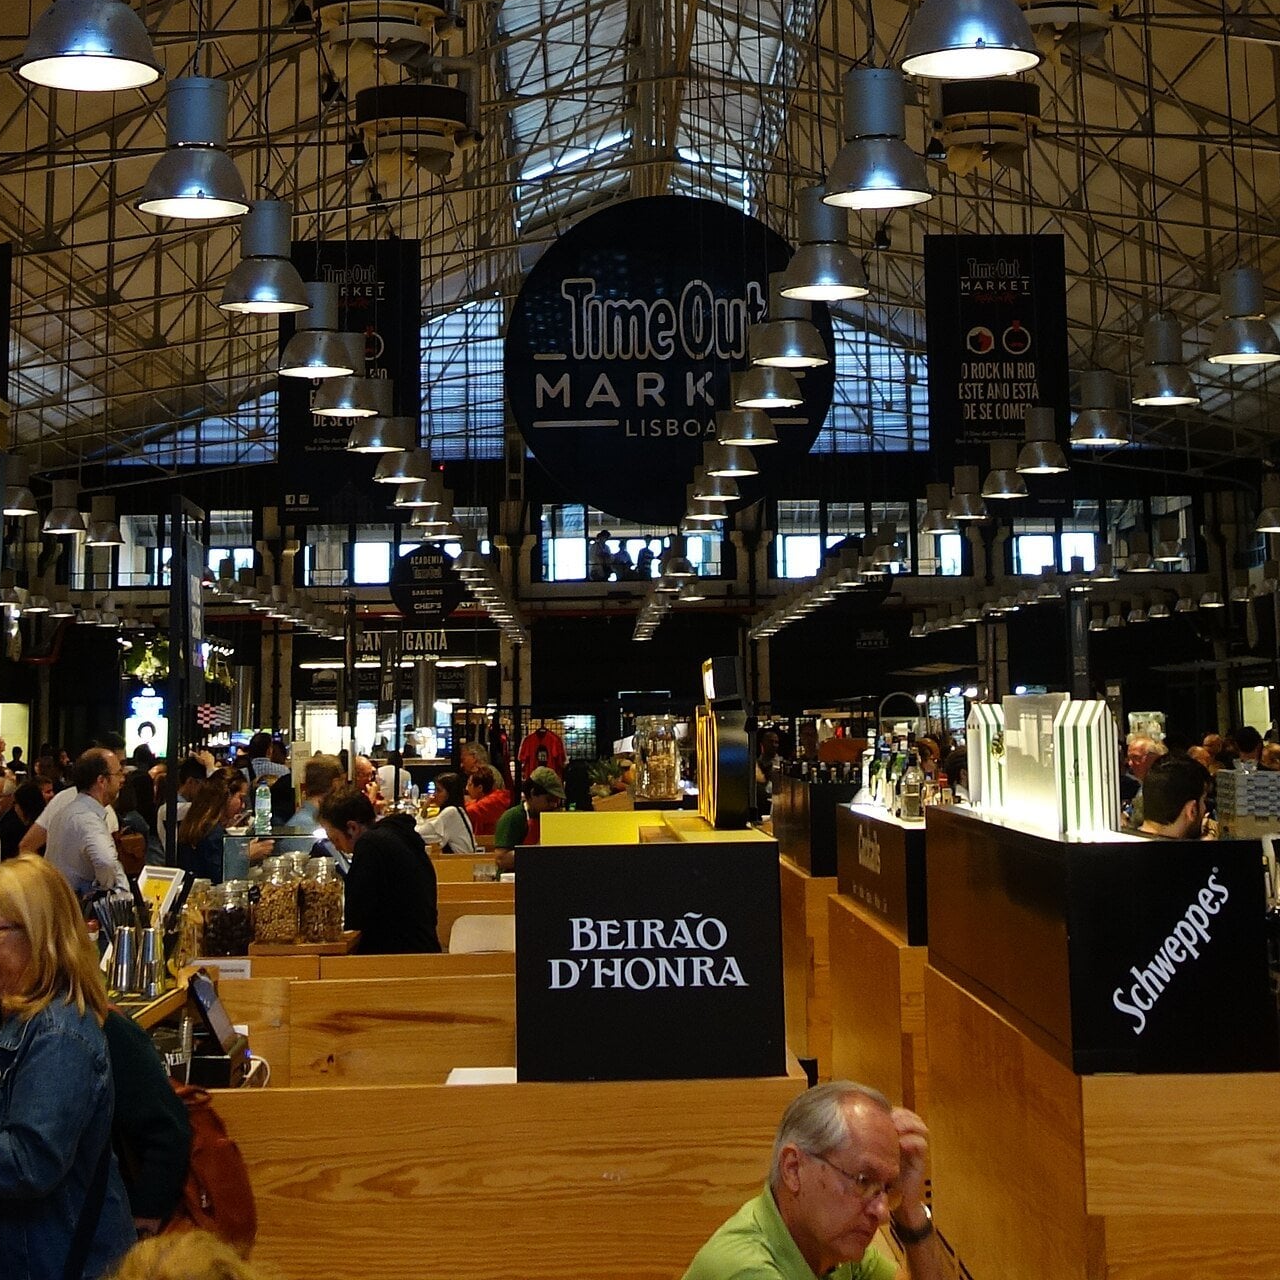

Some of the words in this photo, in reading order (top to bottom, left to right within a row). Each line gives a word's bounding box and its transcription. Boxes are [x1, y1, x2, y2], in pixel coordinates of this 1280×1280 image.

[960, 280, 1031, 291] MARKET
[971, 362, 1000, 380] ROCK
[1002, 362, 1016, 379] IN
[1017, 361, 1036, 379] RIO
[958, 382, 985, 401] ESTE
[987, 381, 1011, 400] ANO
[1012, 378, 1041, 400] ESTÁ
[979, 403, 994, 421] SE
[995, 402, 1033, 421] COME
[624, 418, 718, 438] LISBOA
[410, 555, 444, 567] ACADEMIA
[568, 911, 729, 952] BEIRÃO
[1111, 873, 1230, 1036] Schweppes
[546, 956, 750, 991] D'HONRA
